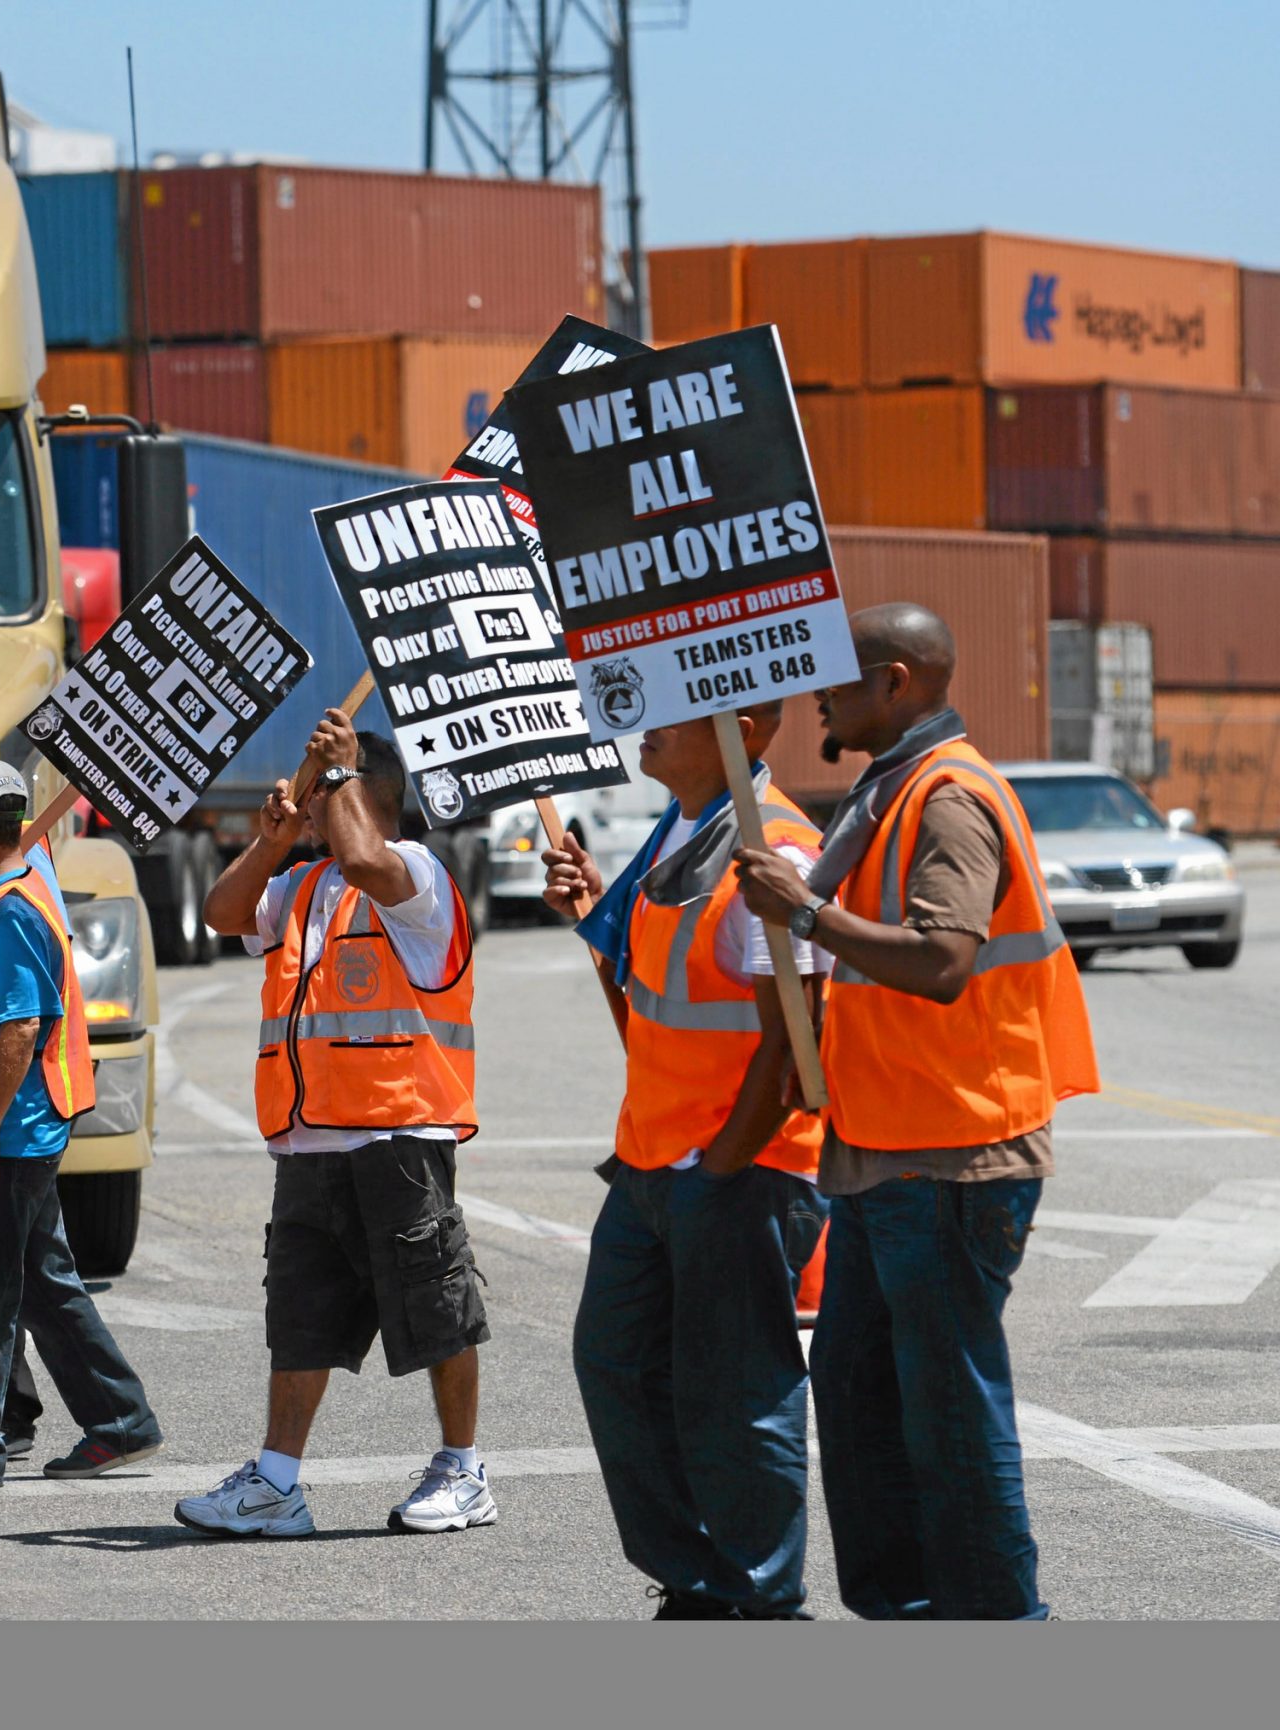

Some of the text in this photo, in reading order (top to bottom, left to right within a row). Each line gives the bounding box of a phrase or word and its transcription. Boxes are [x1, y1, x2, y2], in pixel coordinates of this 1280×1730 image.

[557, 387, 643, 455] WE
[648, 363, 744, 435] ARE
[629, 449, 713, 516] ALL
[335, 494, 516, 573] UNFAIR!
[554, 500, 819, 610] EMPLOYEES
[169, 552, 298, 693] UNFAIR!
[359, 562, 535, 619] PICKETING AIMED
[581, 577, 825, 655] JUSTICE FOR PORT DRIVERS
[141, 593, 258, 720] PICKETING AIMED
[372, 631, 431, 668] ONLY
[432, 623, 459, 652] AT
[508, 611, 525, 636] 9
[544, 609, 564, 634] &
[674, 618, 812, 673] TEAMSTERS
[112, 620, 238, 758] ONLY AT GFS &
[427, 666, 503, 706] OTHER
[685, 653, 816, 705] LOCAL 848
[79, 699, 166, 792] ON STRIKE
[105, 670, 150, 724] OTHER
[143, 711, 210, 785] EMPLOYER
[445, 701, 570, 750] ON STRIKE
[54, 729, 161, 841] TEAMSTERS LOCAL 848
[461, 745, 619, 796] TEAMSTERS LOCAL 848
